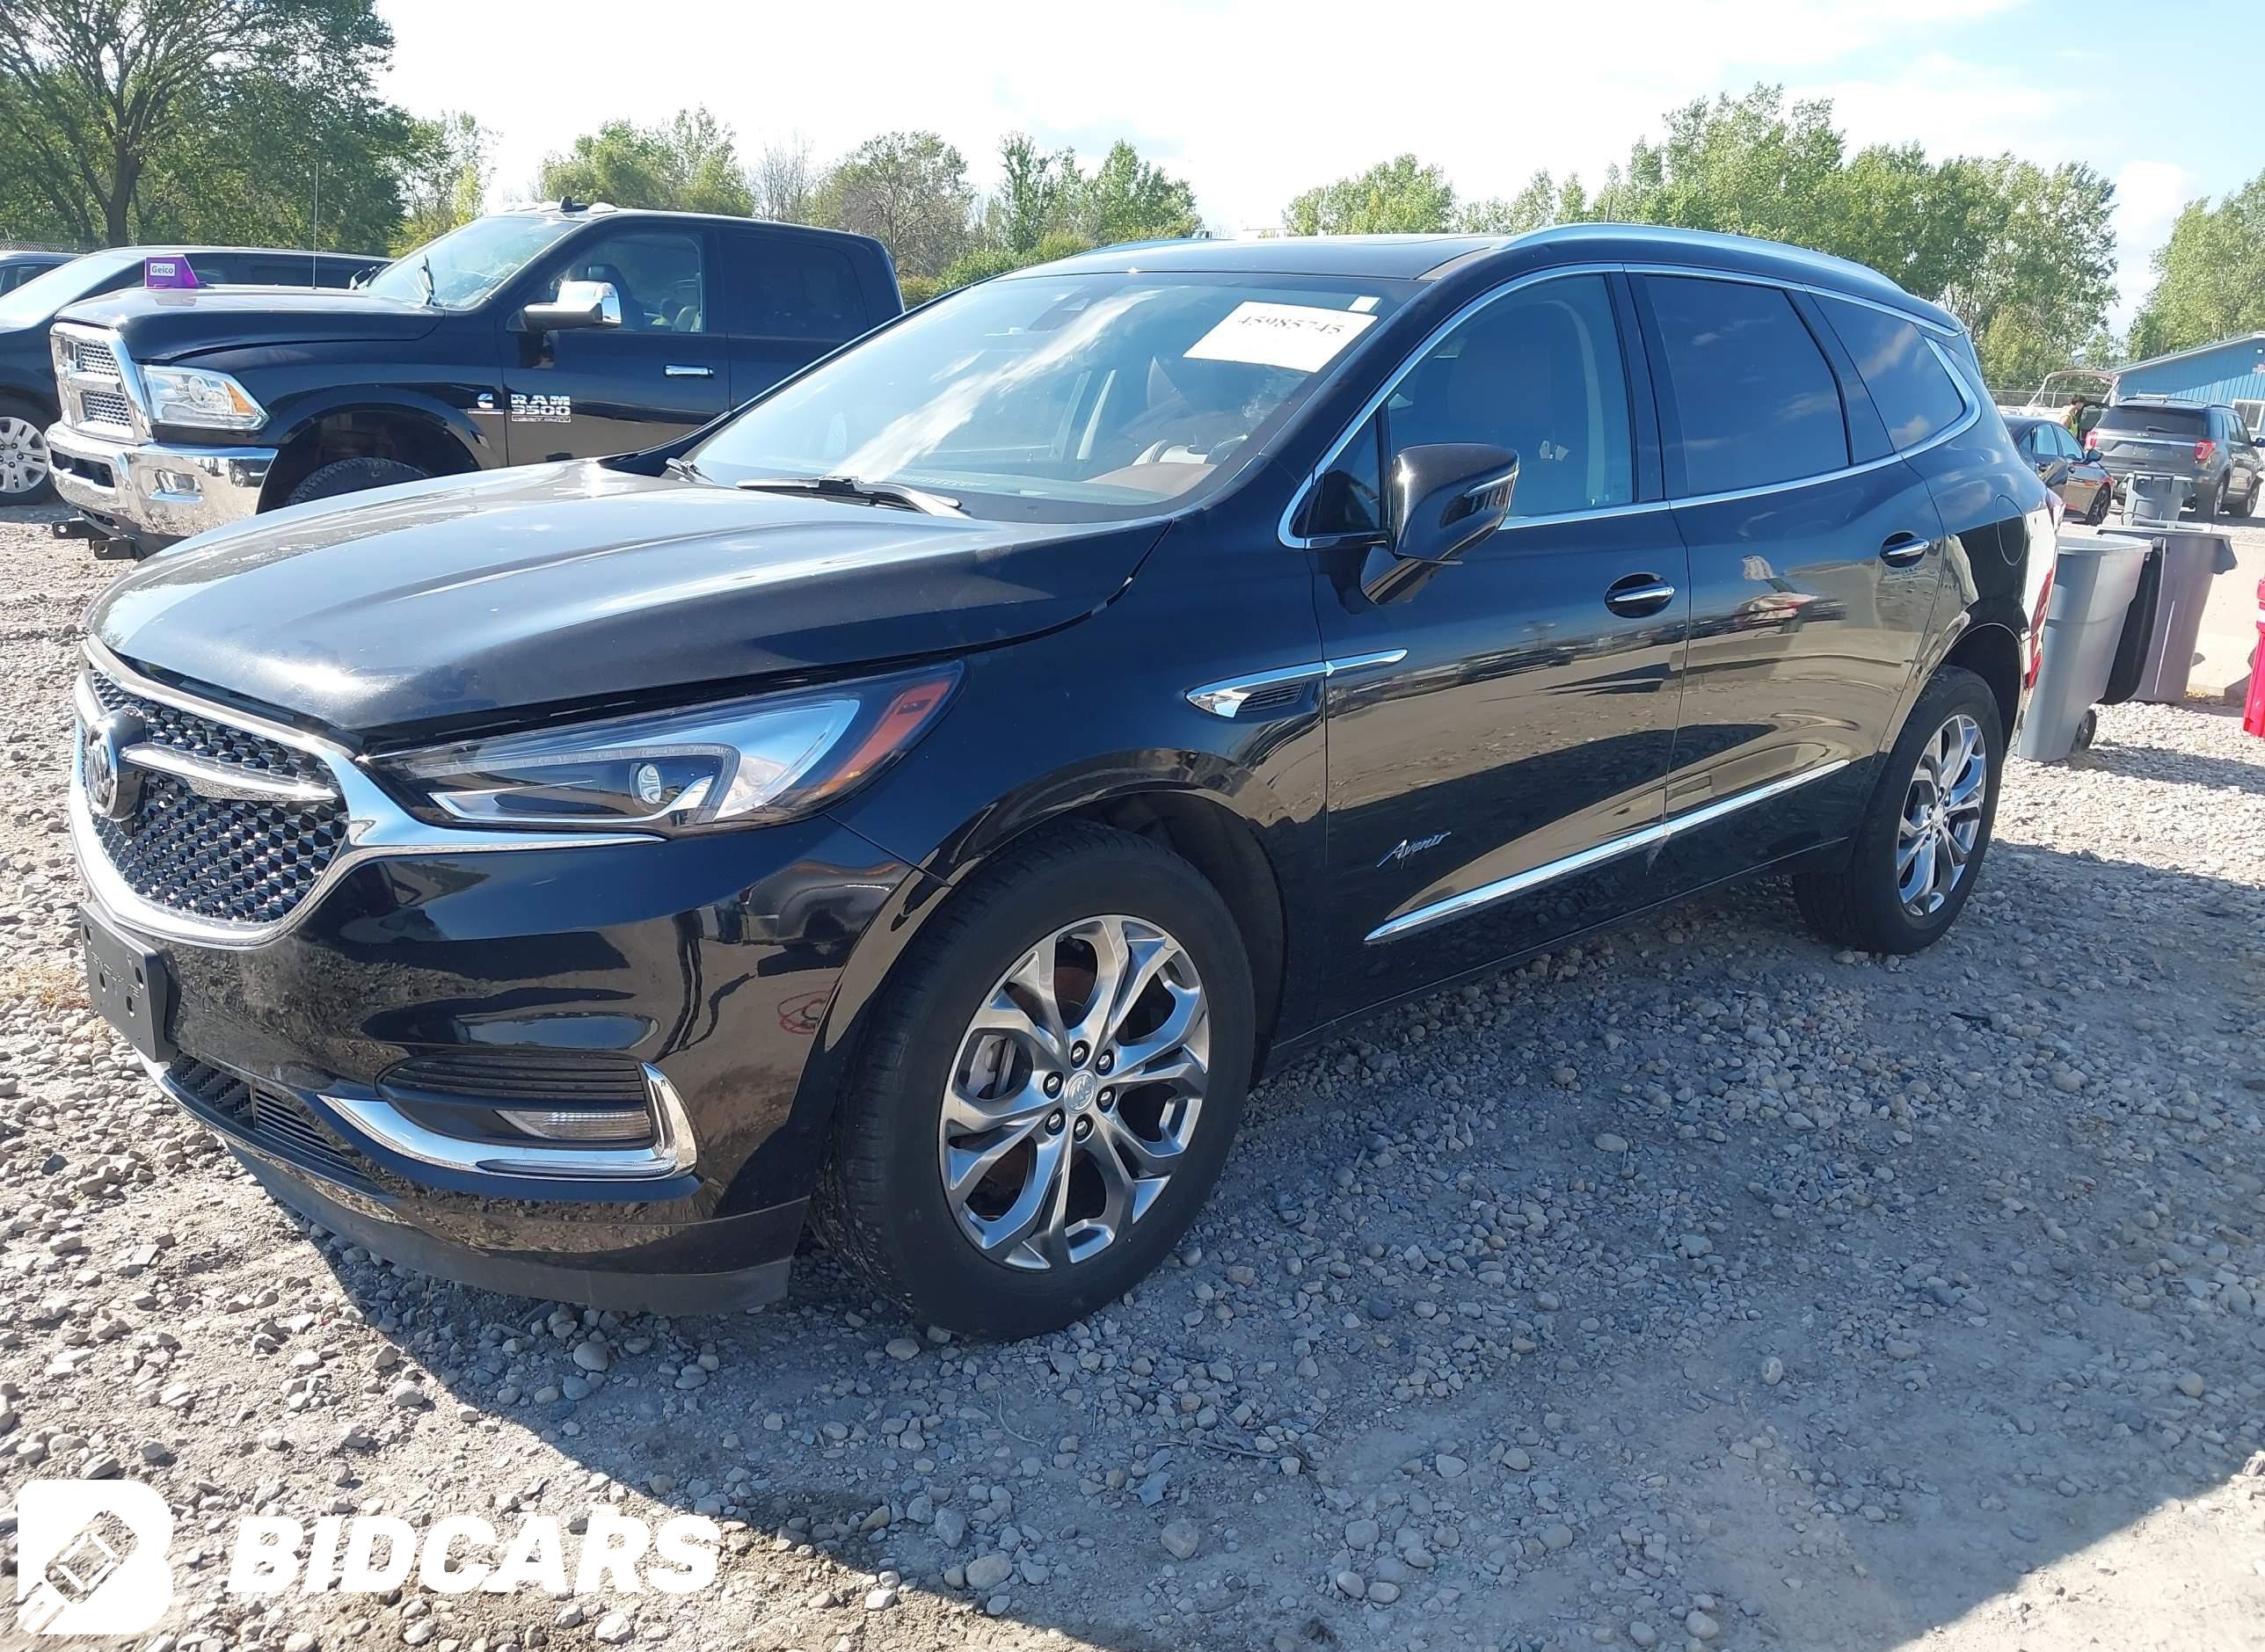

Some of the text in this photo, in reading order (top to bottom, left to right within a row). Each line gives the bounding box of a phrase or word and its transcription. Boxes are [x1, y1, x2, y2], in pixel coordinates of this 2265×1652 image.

[151, 266, 174, 274] Geico
[510, 393, 571, 406] RAM
[511, 405, 572, 416] 3500
